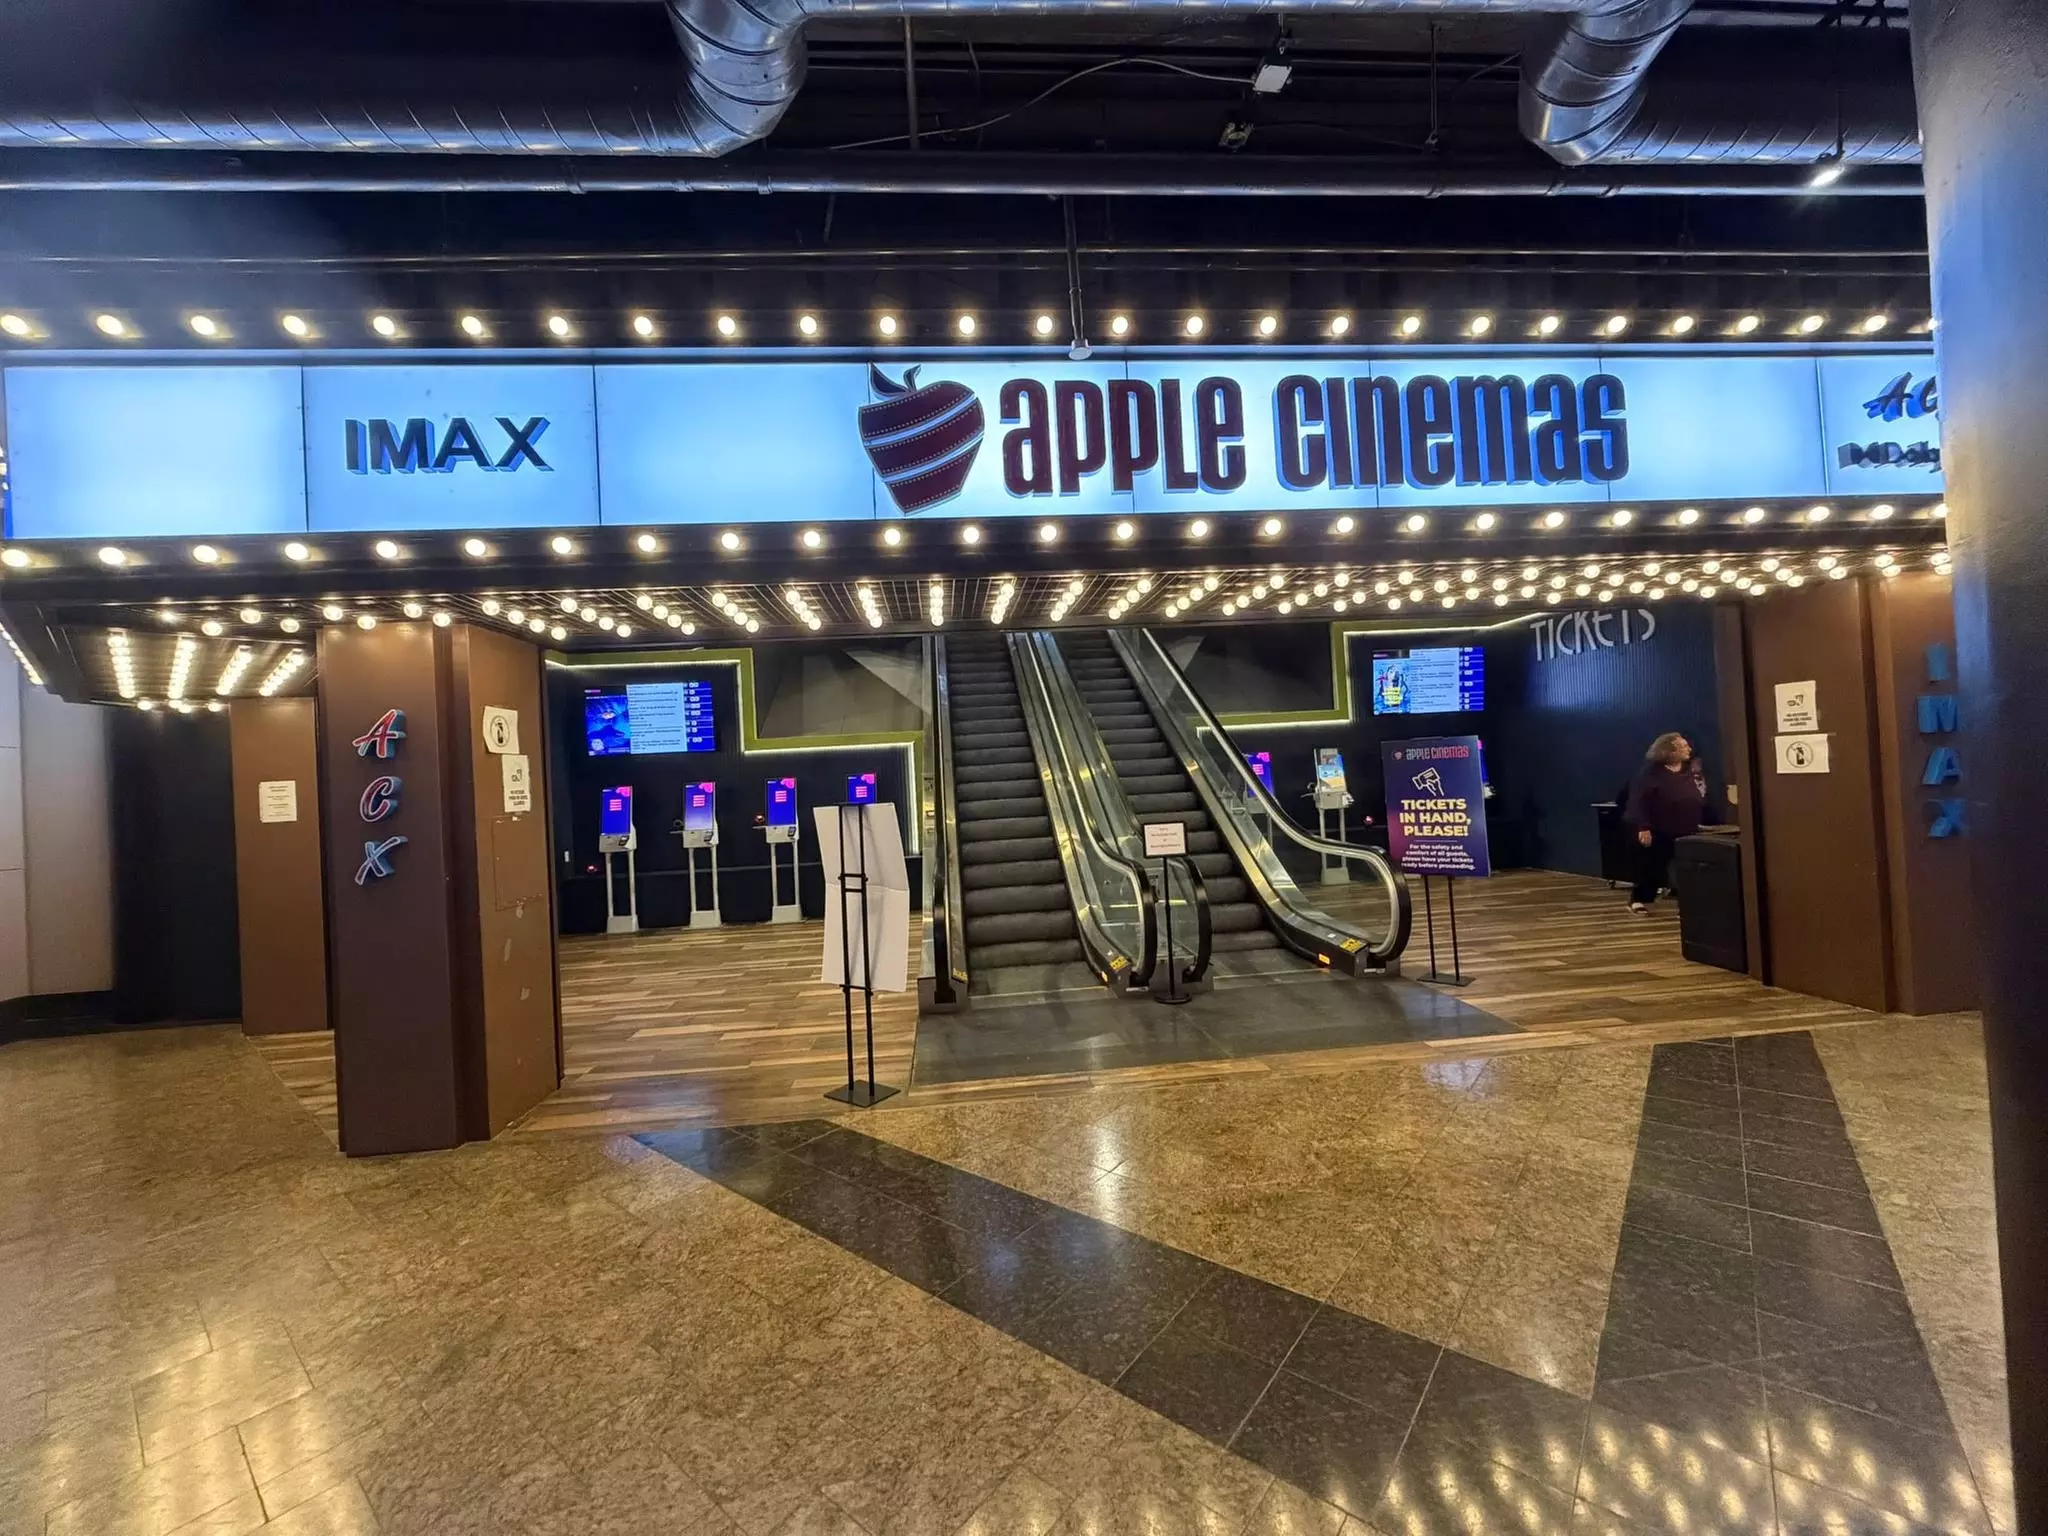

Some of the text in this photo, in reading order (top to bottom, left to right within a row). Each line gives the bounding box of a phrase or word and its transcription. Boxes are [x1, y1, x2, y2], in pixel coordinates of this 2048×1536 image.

[1862, 371, 1938, 422] AC
[345, 417, 554, 475] IMAX
[352, 708, 408, 886] ACX
[1400, 798, 1467, 811] TICKETS
[1399, 811, 1472, 825] IN HAND,
[1403, 825, 1469, 837] PLEASE!
